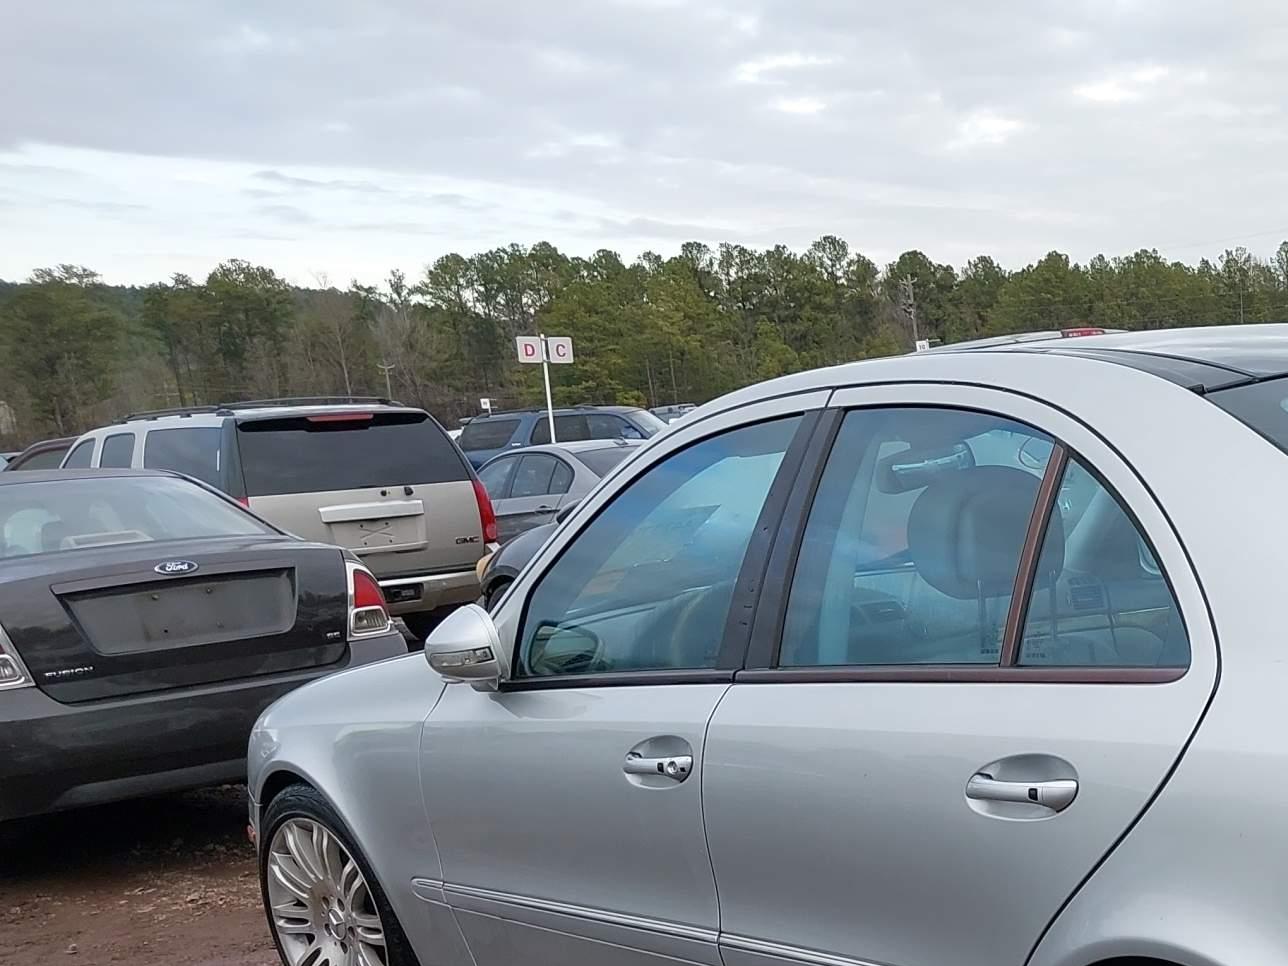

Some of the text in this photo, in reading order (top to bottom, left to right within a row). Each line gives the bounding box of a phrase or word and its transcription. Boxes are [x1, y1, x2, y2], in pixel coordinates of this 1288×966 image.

[524, 343, 535, 357] D
[556, 344, 566, 357] C
[455, 536, 480, 544] GMC
